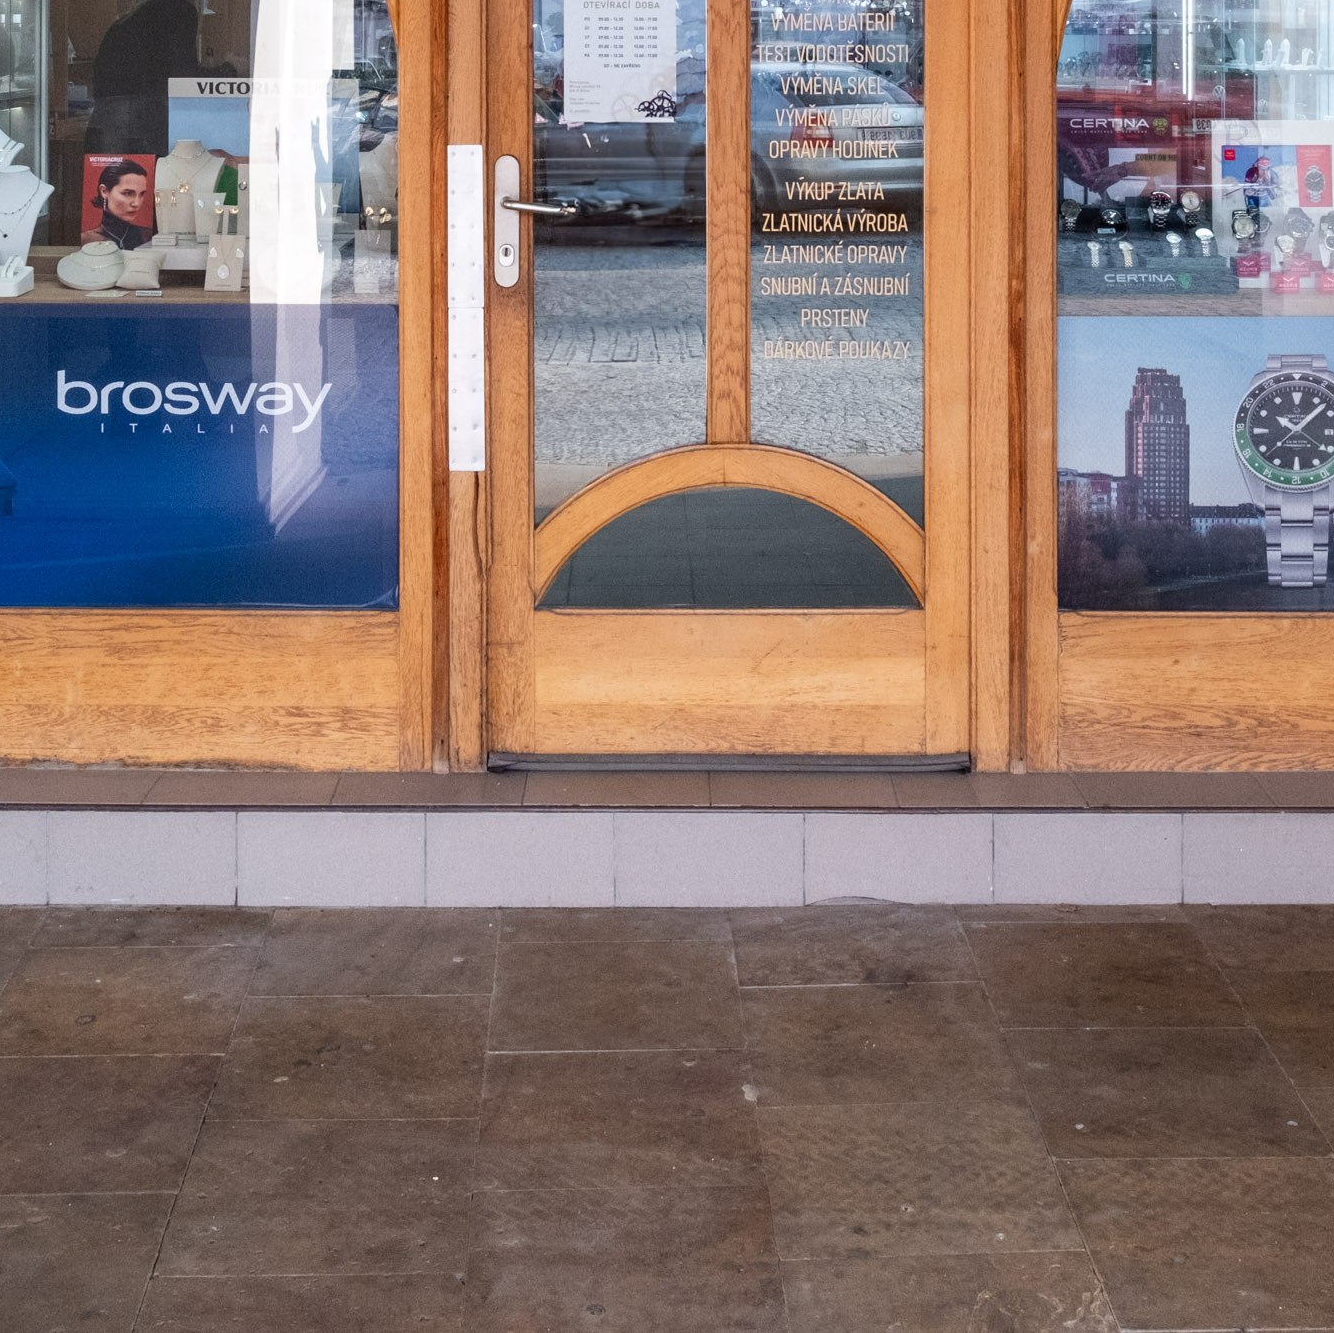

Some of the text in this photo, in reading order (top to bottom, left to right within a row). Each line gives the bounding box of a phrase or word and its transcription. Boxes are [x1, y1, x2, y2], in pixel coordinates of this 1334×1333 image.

[583, 0, 660, 9] OTEVÍRACÍ DOBA
[770, 7, 834, 31] VÝMĚNA
[756, 40, 909, 63] TEST VODOTĚSNOSTI
[780, 72, 886, 95] VÝMĚNA SKEL
[775, 102, 892, 127] VÝMĚNA PÁSKŮ
[1069, 118, 1150, 129] CERTINA
[769, 140, 899, 159] OPRAVY HODINEK
[1135, 154, 1156, 162] COUNT
[785, 176, 885, 201] VÝKUP ZLATA
[762, 208, 909, 233] ZLATNICKÁ VÝROBA
[763, 240, 907, 264] ZLATNICKÉ OPRAVY
[760, 272, 911, 296] SNUBNÍ A ZÁSNUBNÍ
[1104, 274, 1176, 283] CERTINA
[801, 308, 870, 328] PRSTENY
[763, 336, 910, 359] DÁRKOVÉ POUKAZY
[1264, 379, 1276, 389] 22
[57, 369, 333, 434] brosway
[1243, 397, 1254, 408] 20
[100, 423, 269, 434] ITALIA
[1291, 476, 1302, 484] 12
